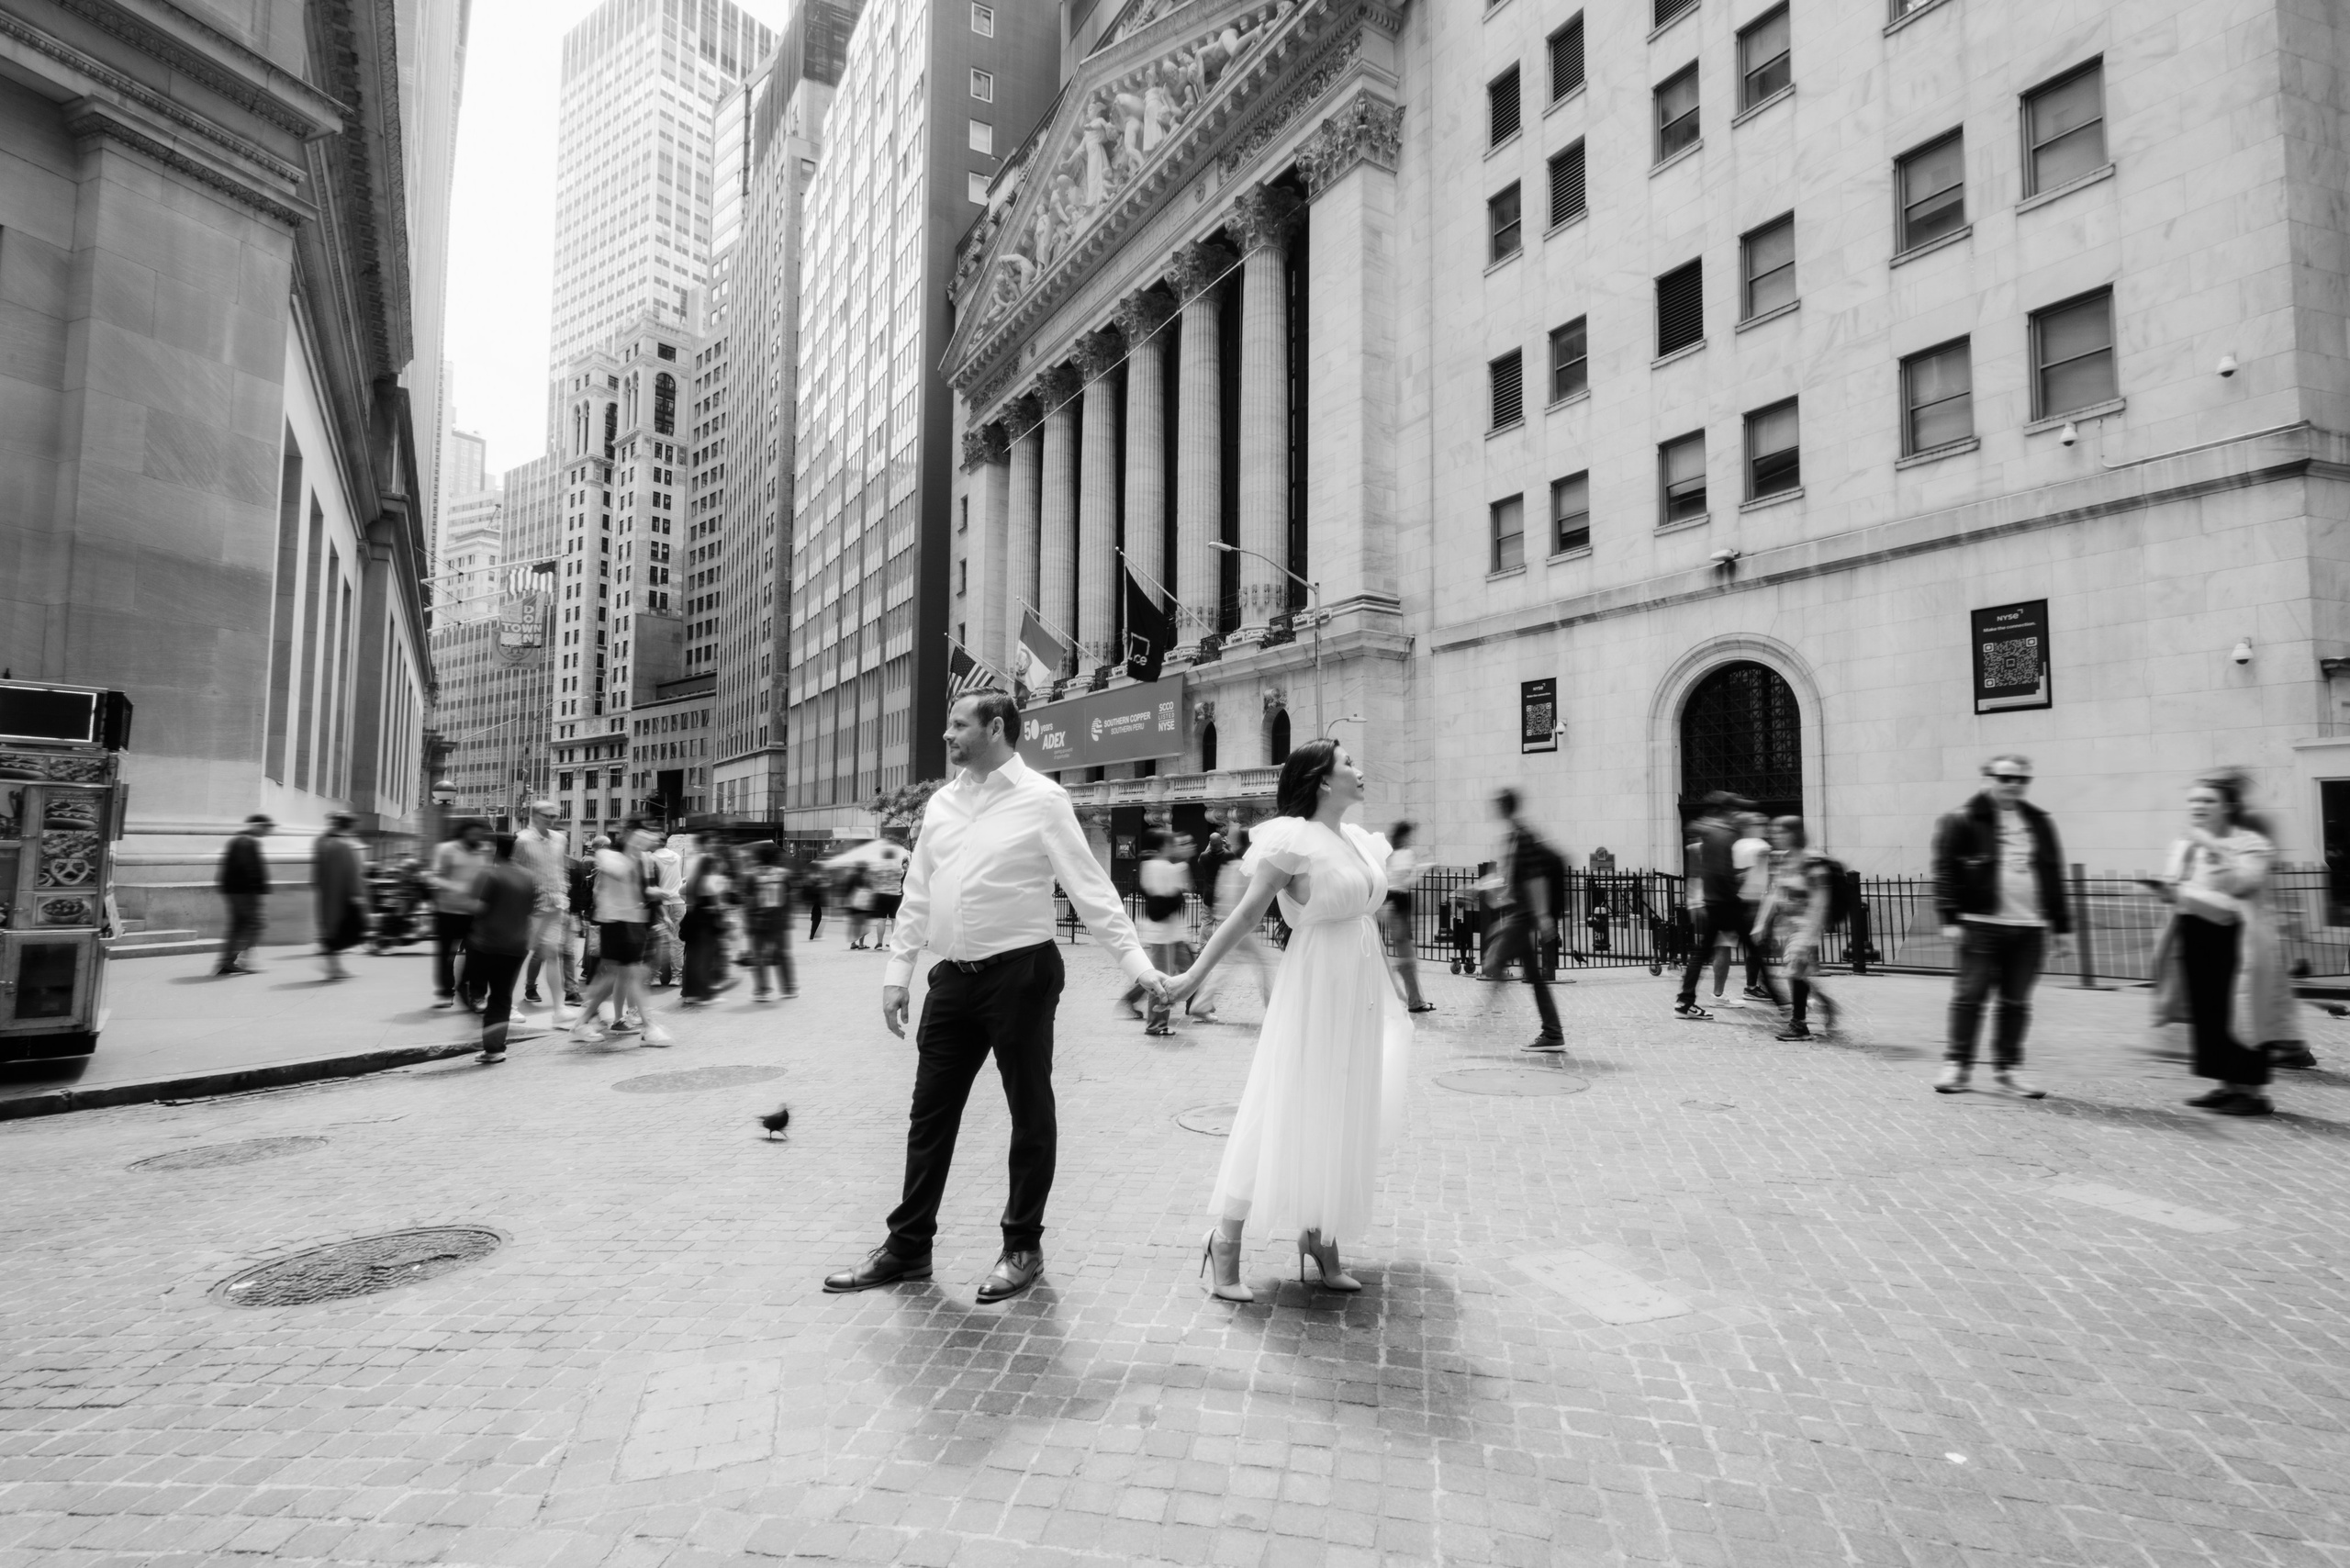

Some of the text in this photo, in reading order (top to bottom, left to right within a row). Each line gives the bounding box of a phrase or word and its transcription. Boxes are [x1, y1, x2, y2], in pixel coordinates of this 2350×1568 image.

[501, 622, 543, 633] TOWN
[1103, 711, 1151, 728] SOUTHERN COPPER
[1158, 712, 1175, 721] LISTED
[1040, 722, 1054, 734] years
[1110, 722, 1145, 735] SOUTHERN PERU
[1158, 721, 1175, 732] NYSE
[1042, 731, 1066, 750] ADEX
